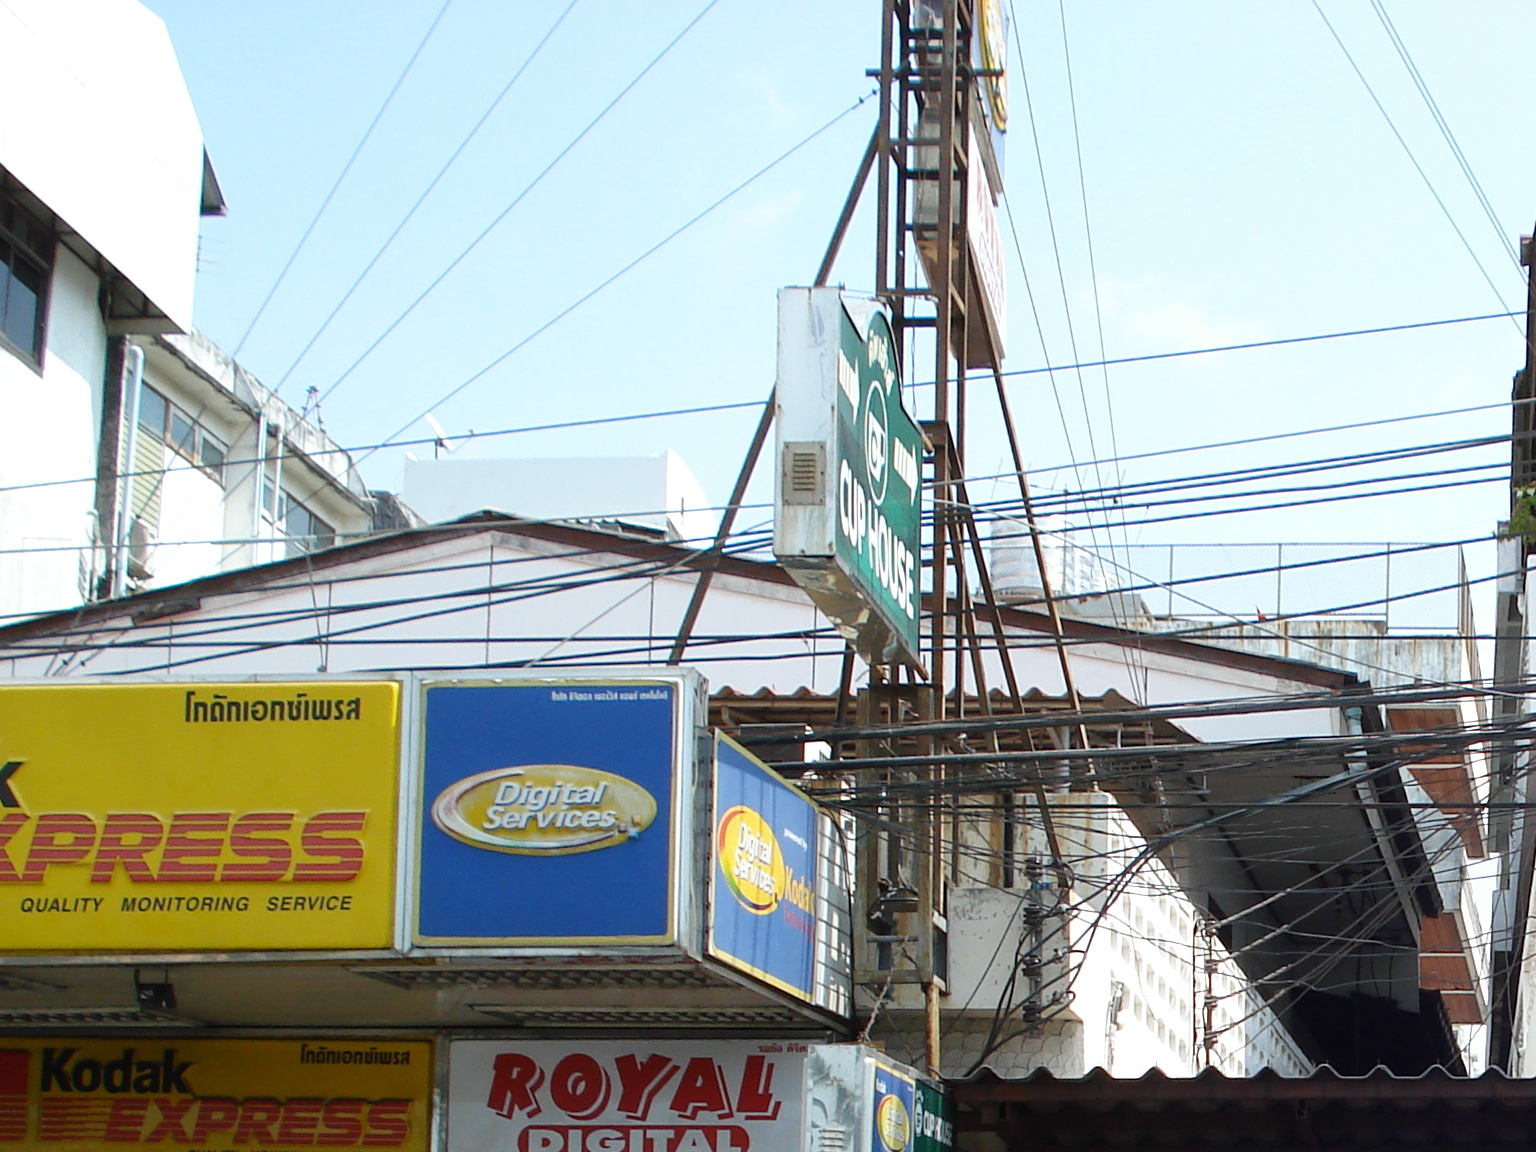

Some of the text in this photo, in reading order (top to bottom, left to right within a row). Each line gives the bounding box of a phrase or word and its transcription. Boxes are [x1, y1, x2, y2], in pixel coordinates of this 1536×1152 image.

[839, 458, 915, 620] CUP HOUSE
[482, 805, 617, 830] Services
[495, 781, 609, 812] Digital
[738, 822, 773, 866] Digital
[734, 850, 776, 895] Services
[784, 864, 815, 917] Kodak
[20, 896, 353, 913] QUALITY MONITORING SERVICE
[41, 1047, 195, 1095] Kodak
[487, 1053, 783, 1121] ROYAL
[105, 1098, 413, 1145] EXPRESS
